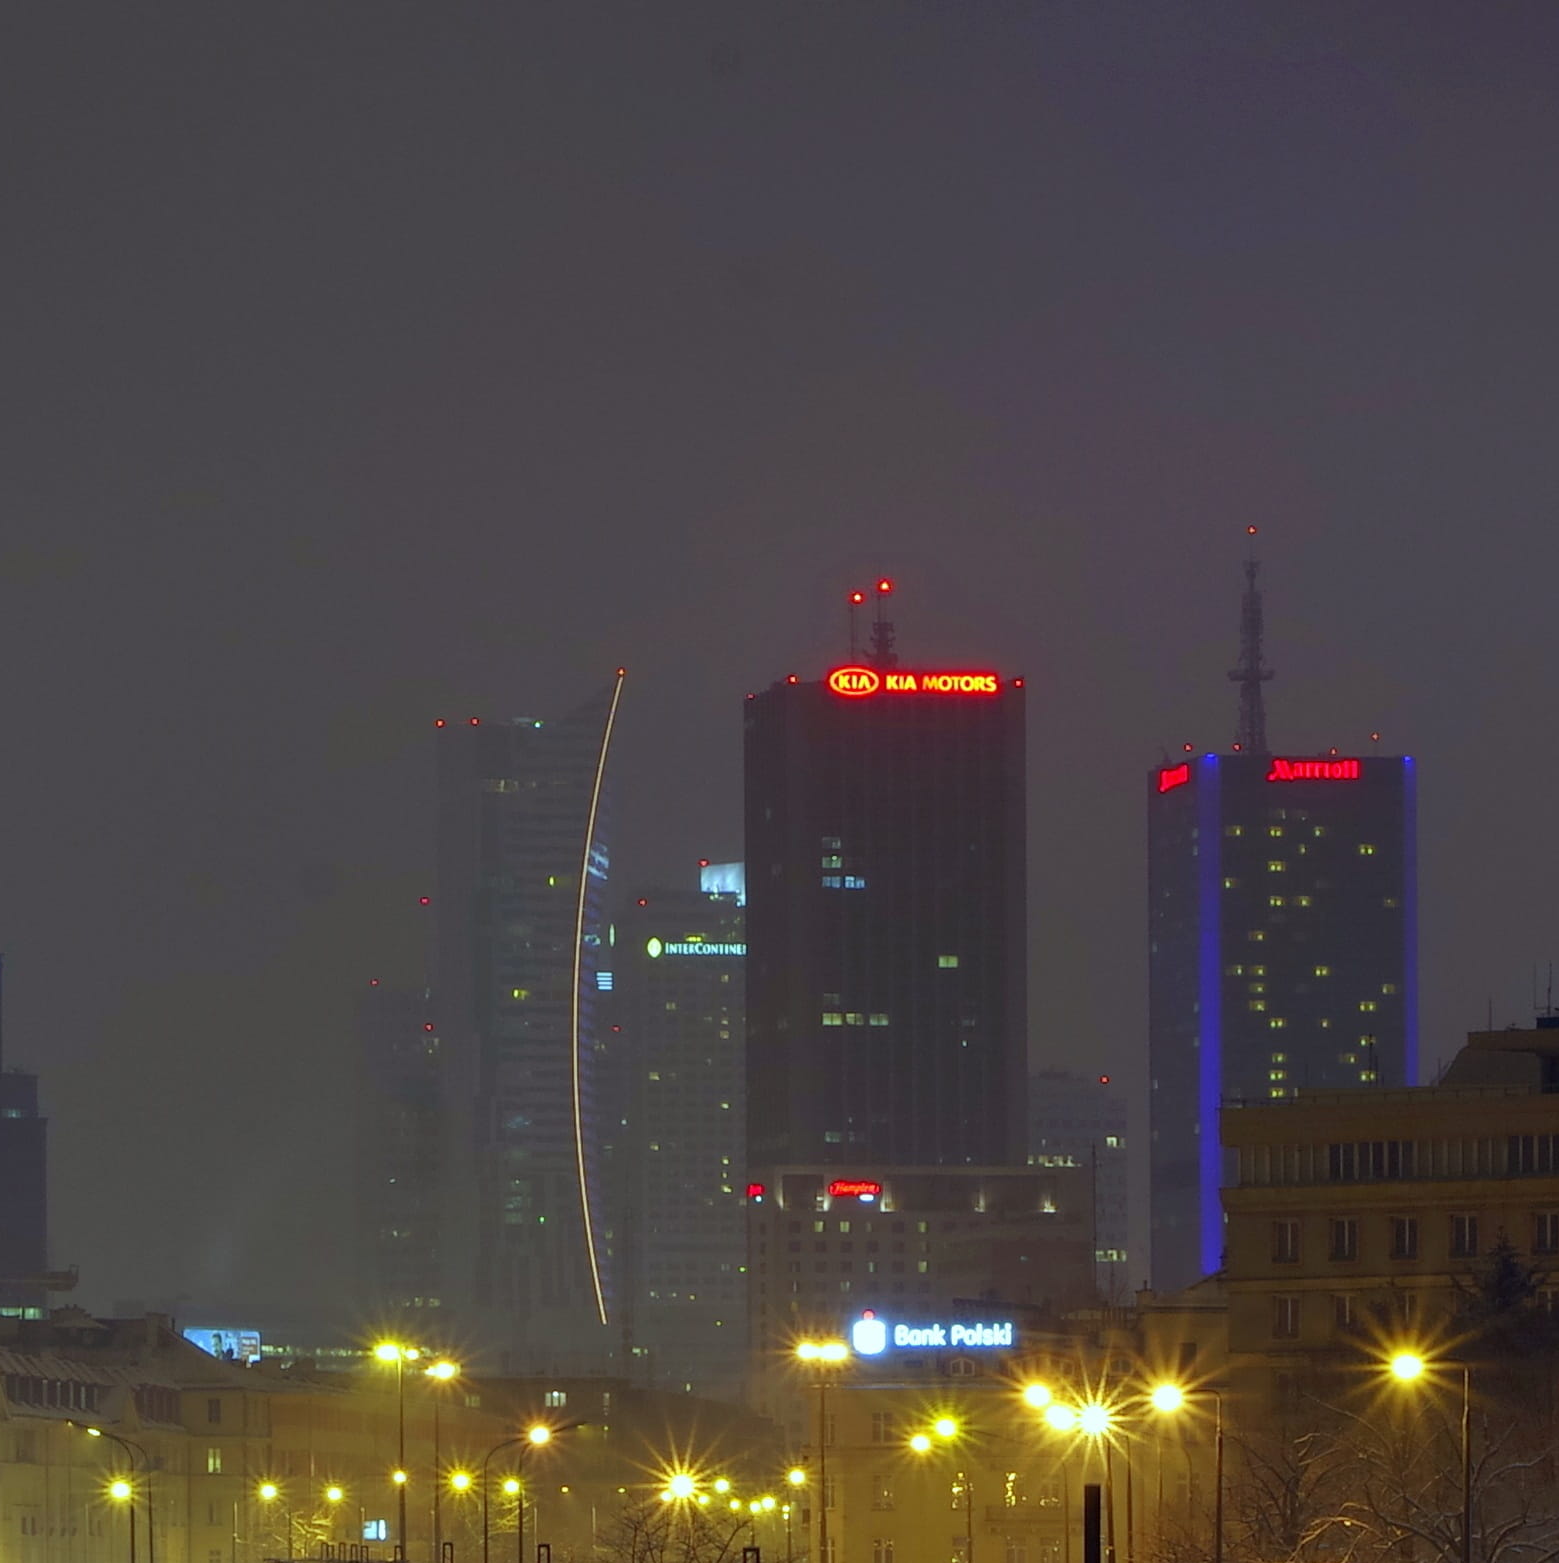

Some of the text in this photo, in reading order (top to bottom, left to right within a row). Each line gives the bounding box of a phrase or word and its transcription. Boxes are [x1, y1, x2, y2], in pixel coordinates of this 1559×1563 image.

[838, 674, 872, 690] KIA
[885, 674, 997, 693] KIA MOTORS
[894, 1322, 1013, 1346] Bank Polski
